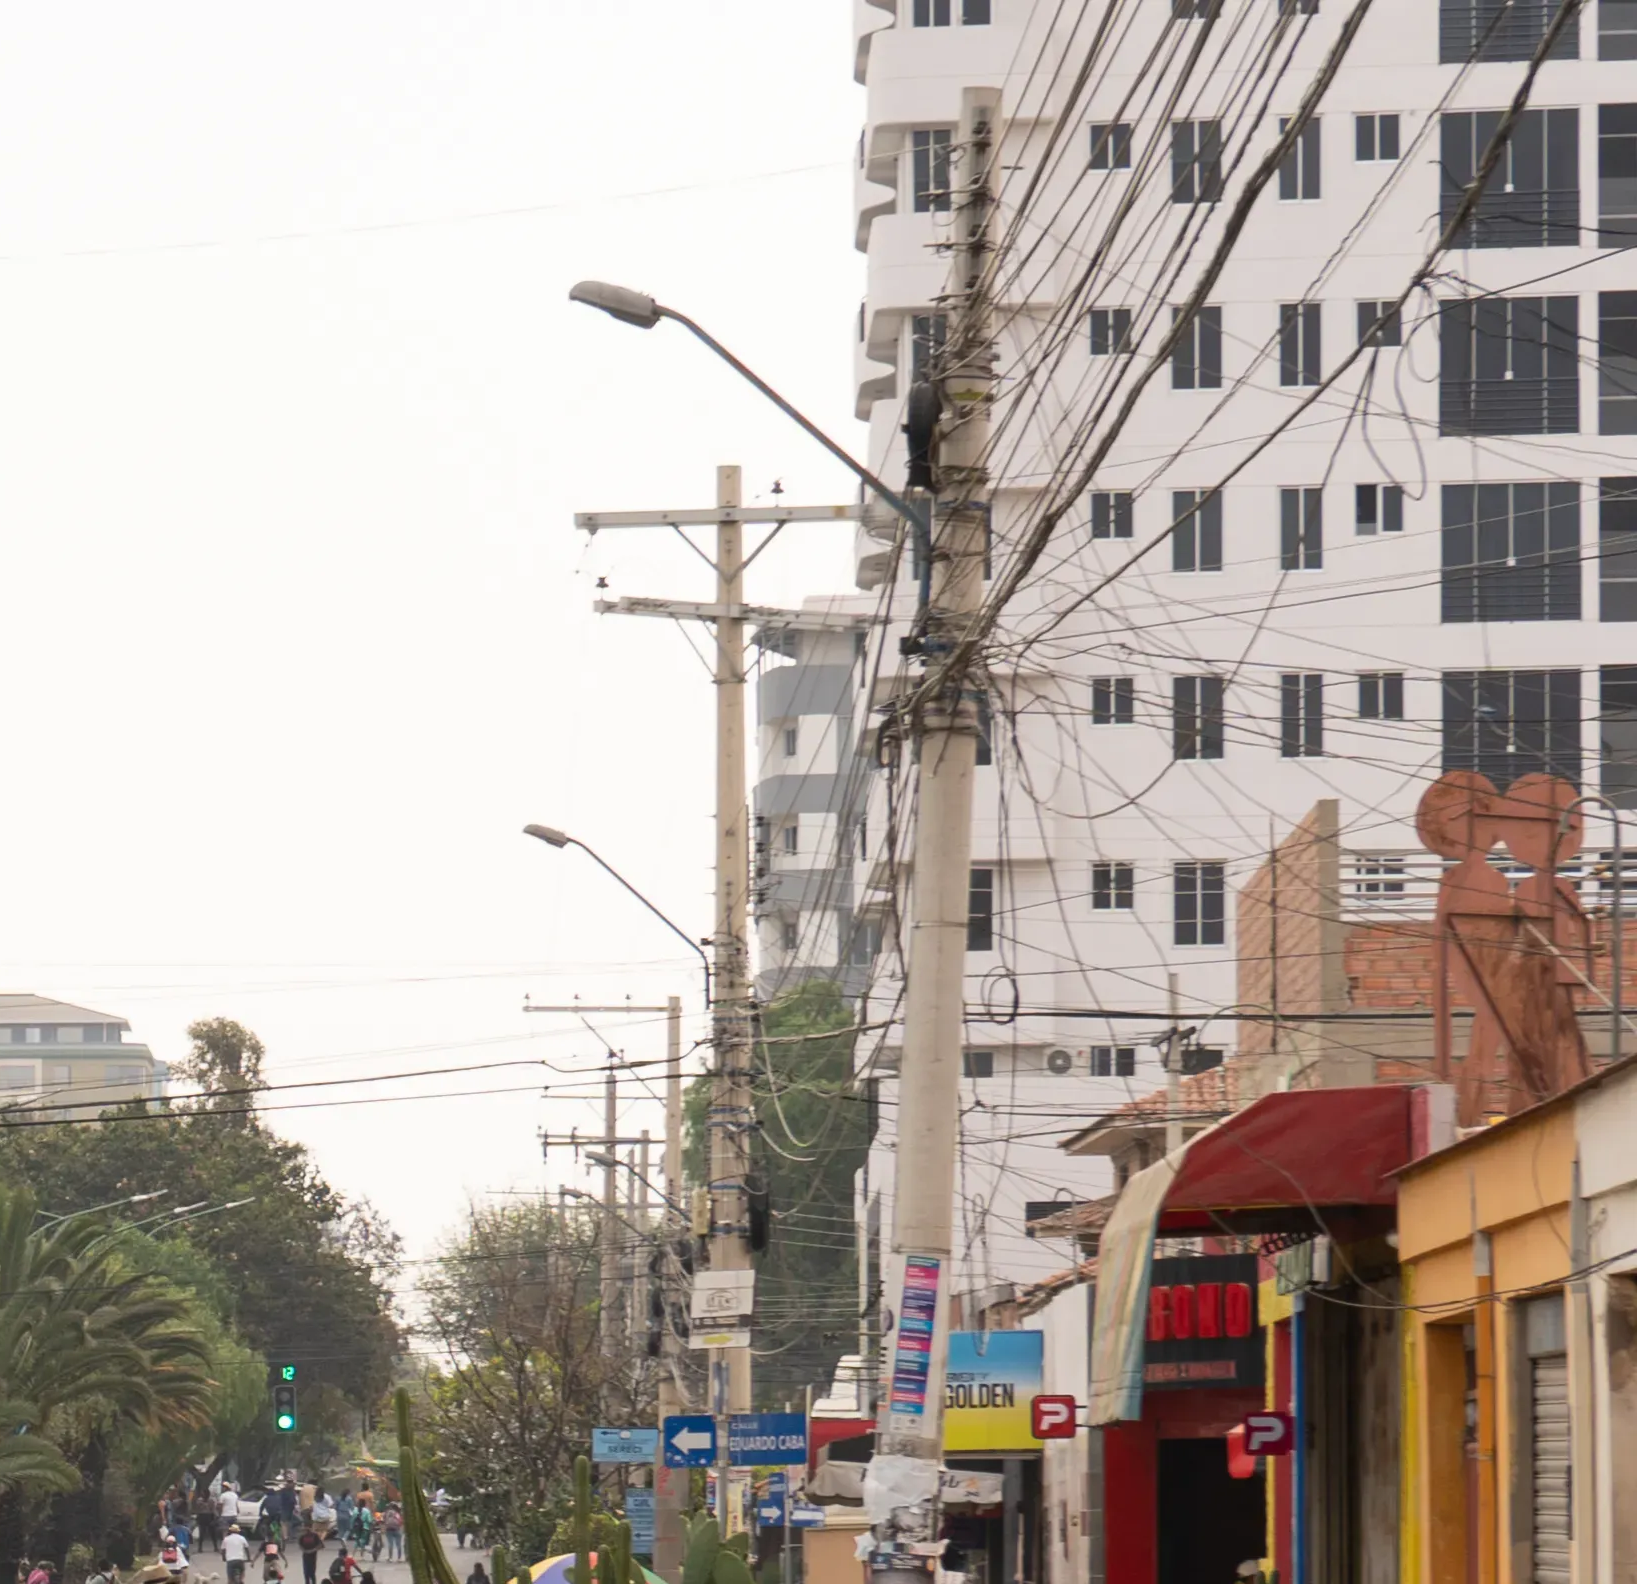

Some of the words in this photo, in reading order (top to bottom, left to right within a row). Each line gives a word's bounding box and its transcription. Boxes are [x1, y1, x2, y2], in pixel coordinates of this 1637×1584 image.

[283, 1366, 295, 1380] 12
[944, 1383, 1014, 1408] GOLDEN
[729, 1435, 776, 1451] EDUARDO
[778, 1435, 805, 1450] CABA
